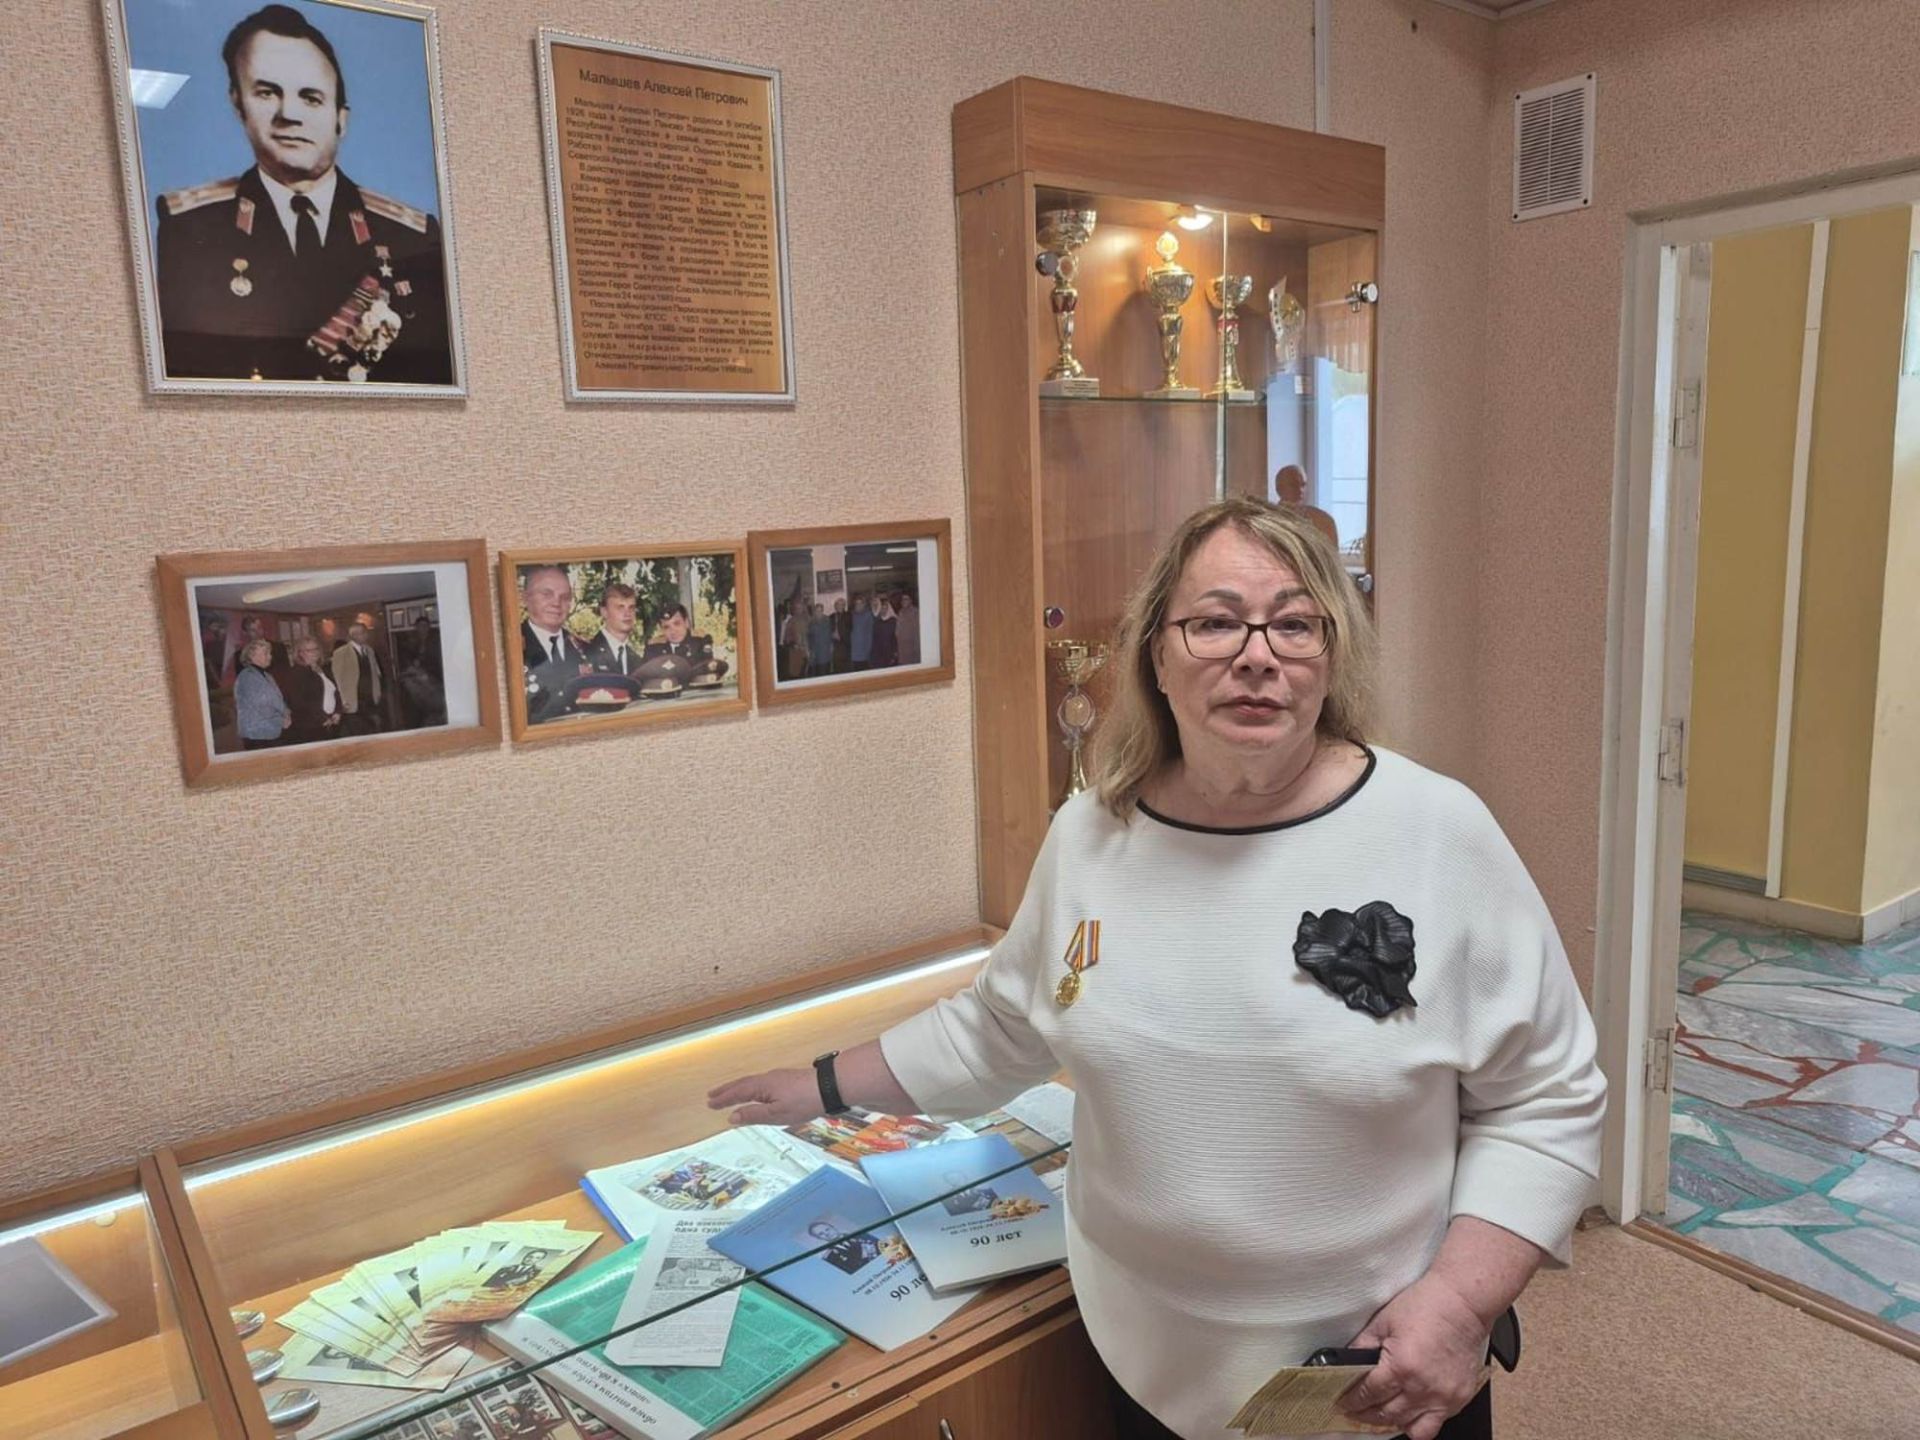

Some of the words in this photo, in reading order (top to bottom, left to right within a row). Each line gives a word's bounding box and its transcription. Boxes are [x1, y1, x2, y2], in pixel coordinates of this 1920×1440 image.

[579, 70, 641, 90] Малышев
[644, 80, 692, 97] Алексей
[696, 88, 748, 106] Петрович
[969, 1235, 990, 1247] 90
[995, 1230, 1023, 1242] лет
[889, 1282, 912, 1303] 90
[911, 1273, 929, 1288] ле
